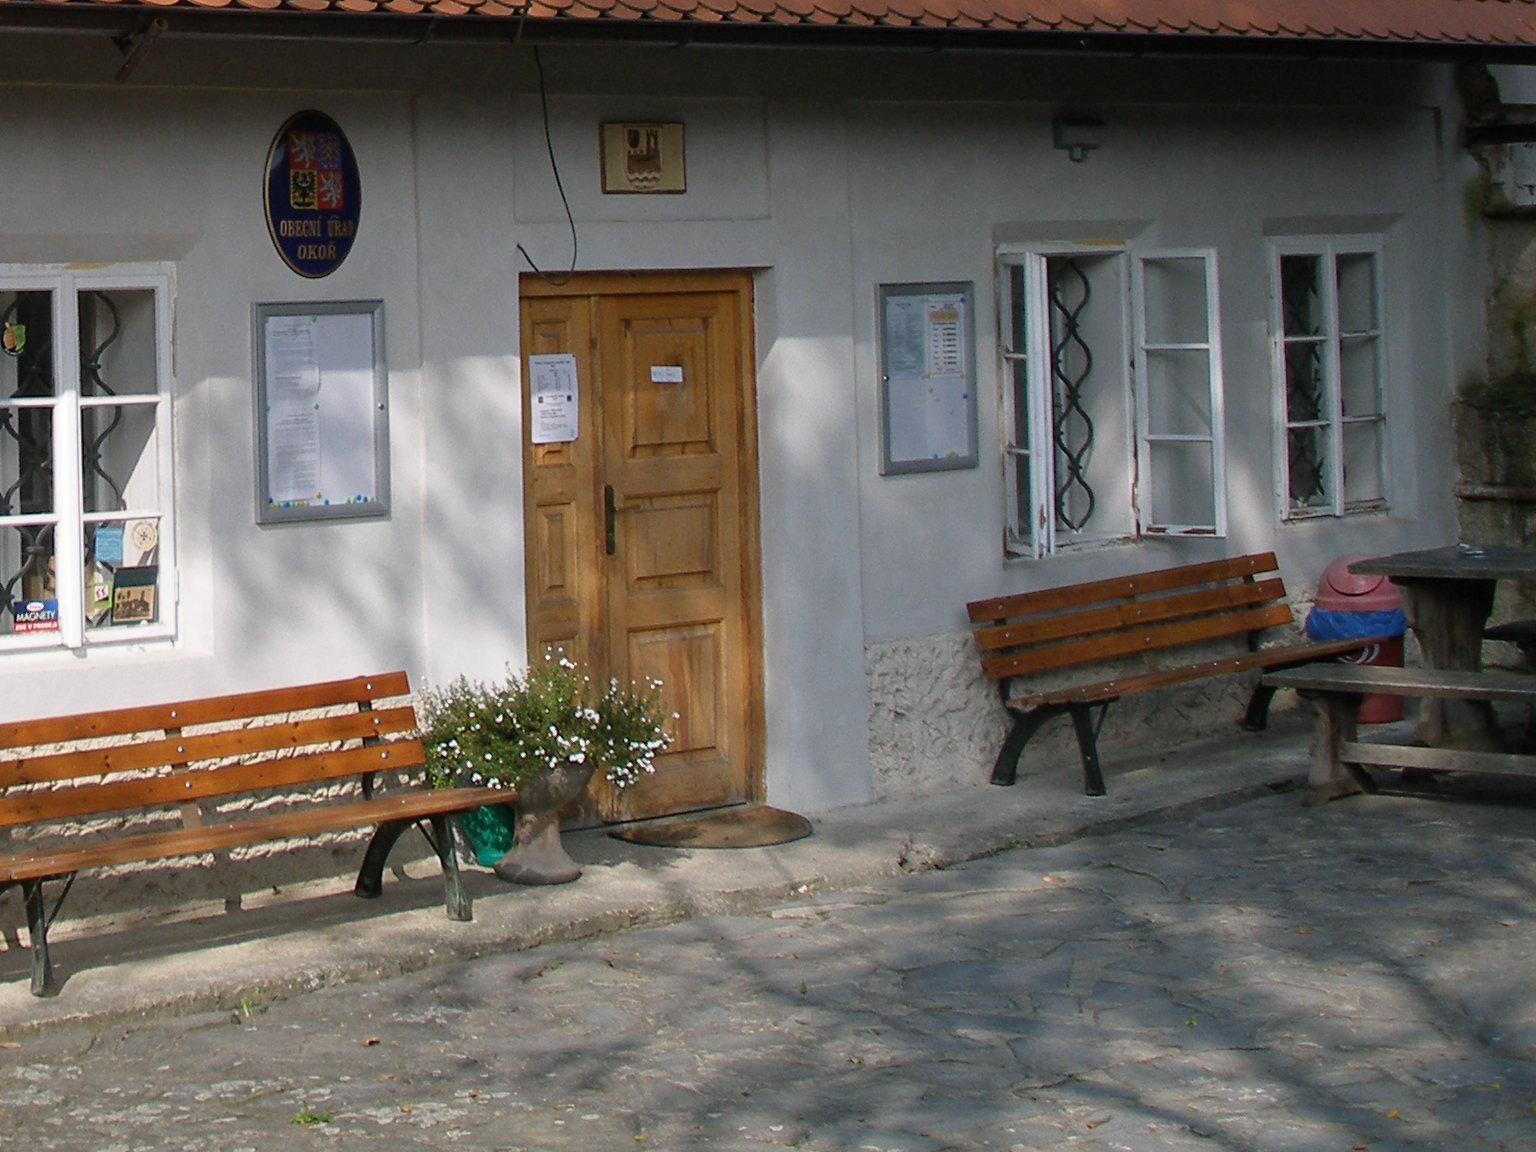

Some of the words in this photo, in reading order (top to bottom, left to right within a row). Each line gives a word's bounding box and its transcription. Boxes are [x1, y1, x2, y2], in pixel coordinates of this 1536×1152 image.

[280, 215, 321, 237] OBECNÍ
[297, 241, 336, 260] OKOŘ
[16, 610, 56, 622] MAGNETY
